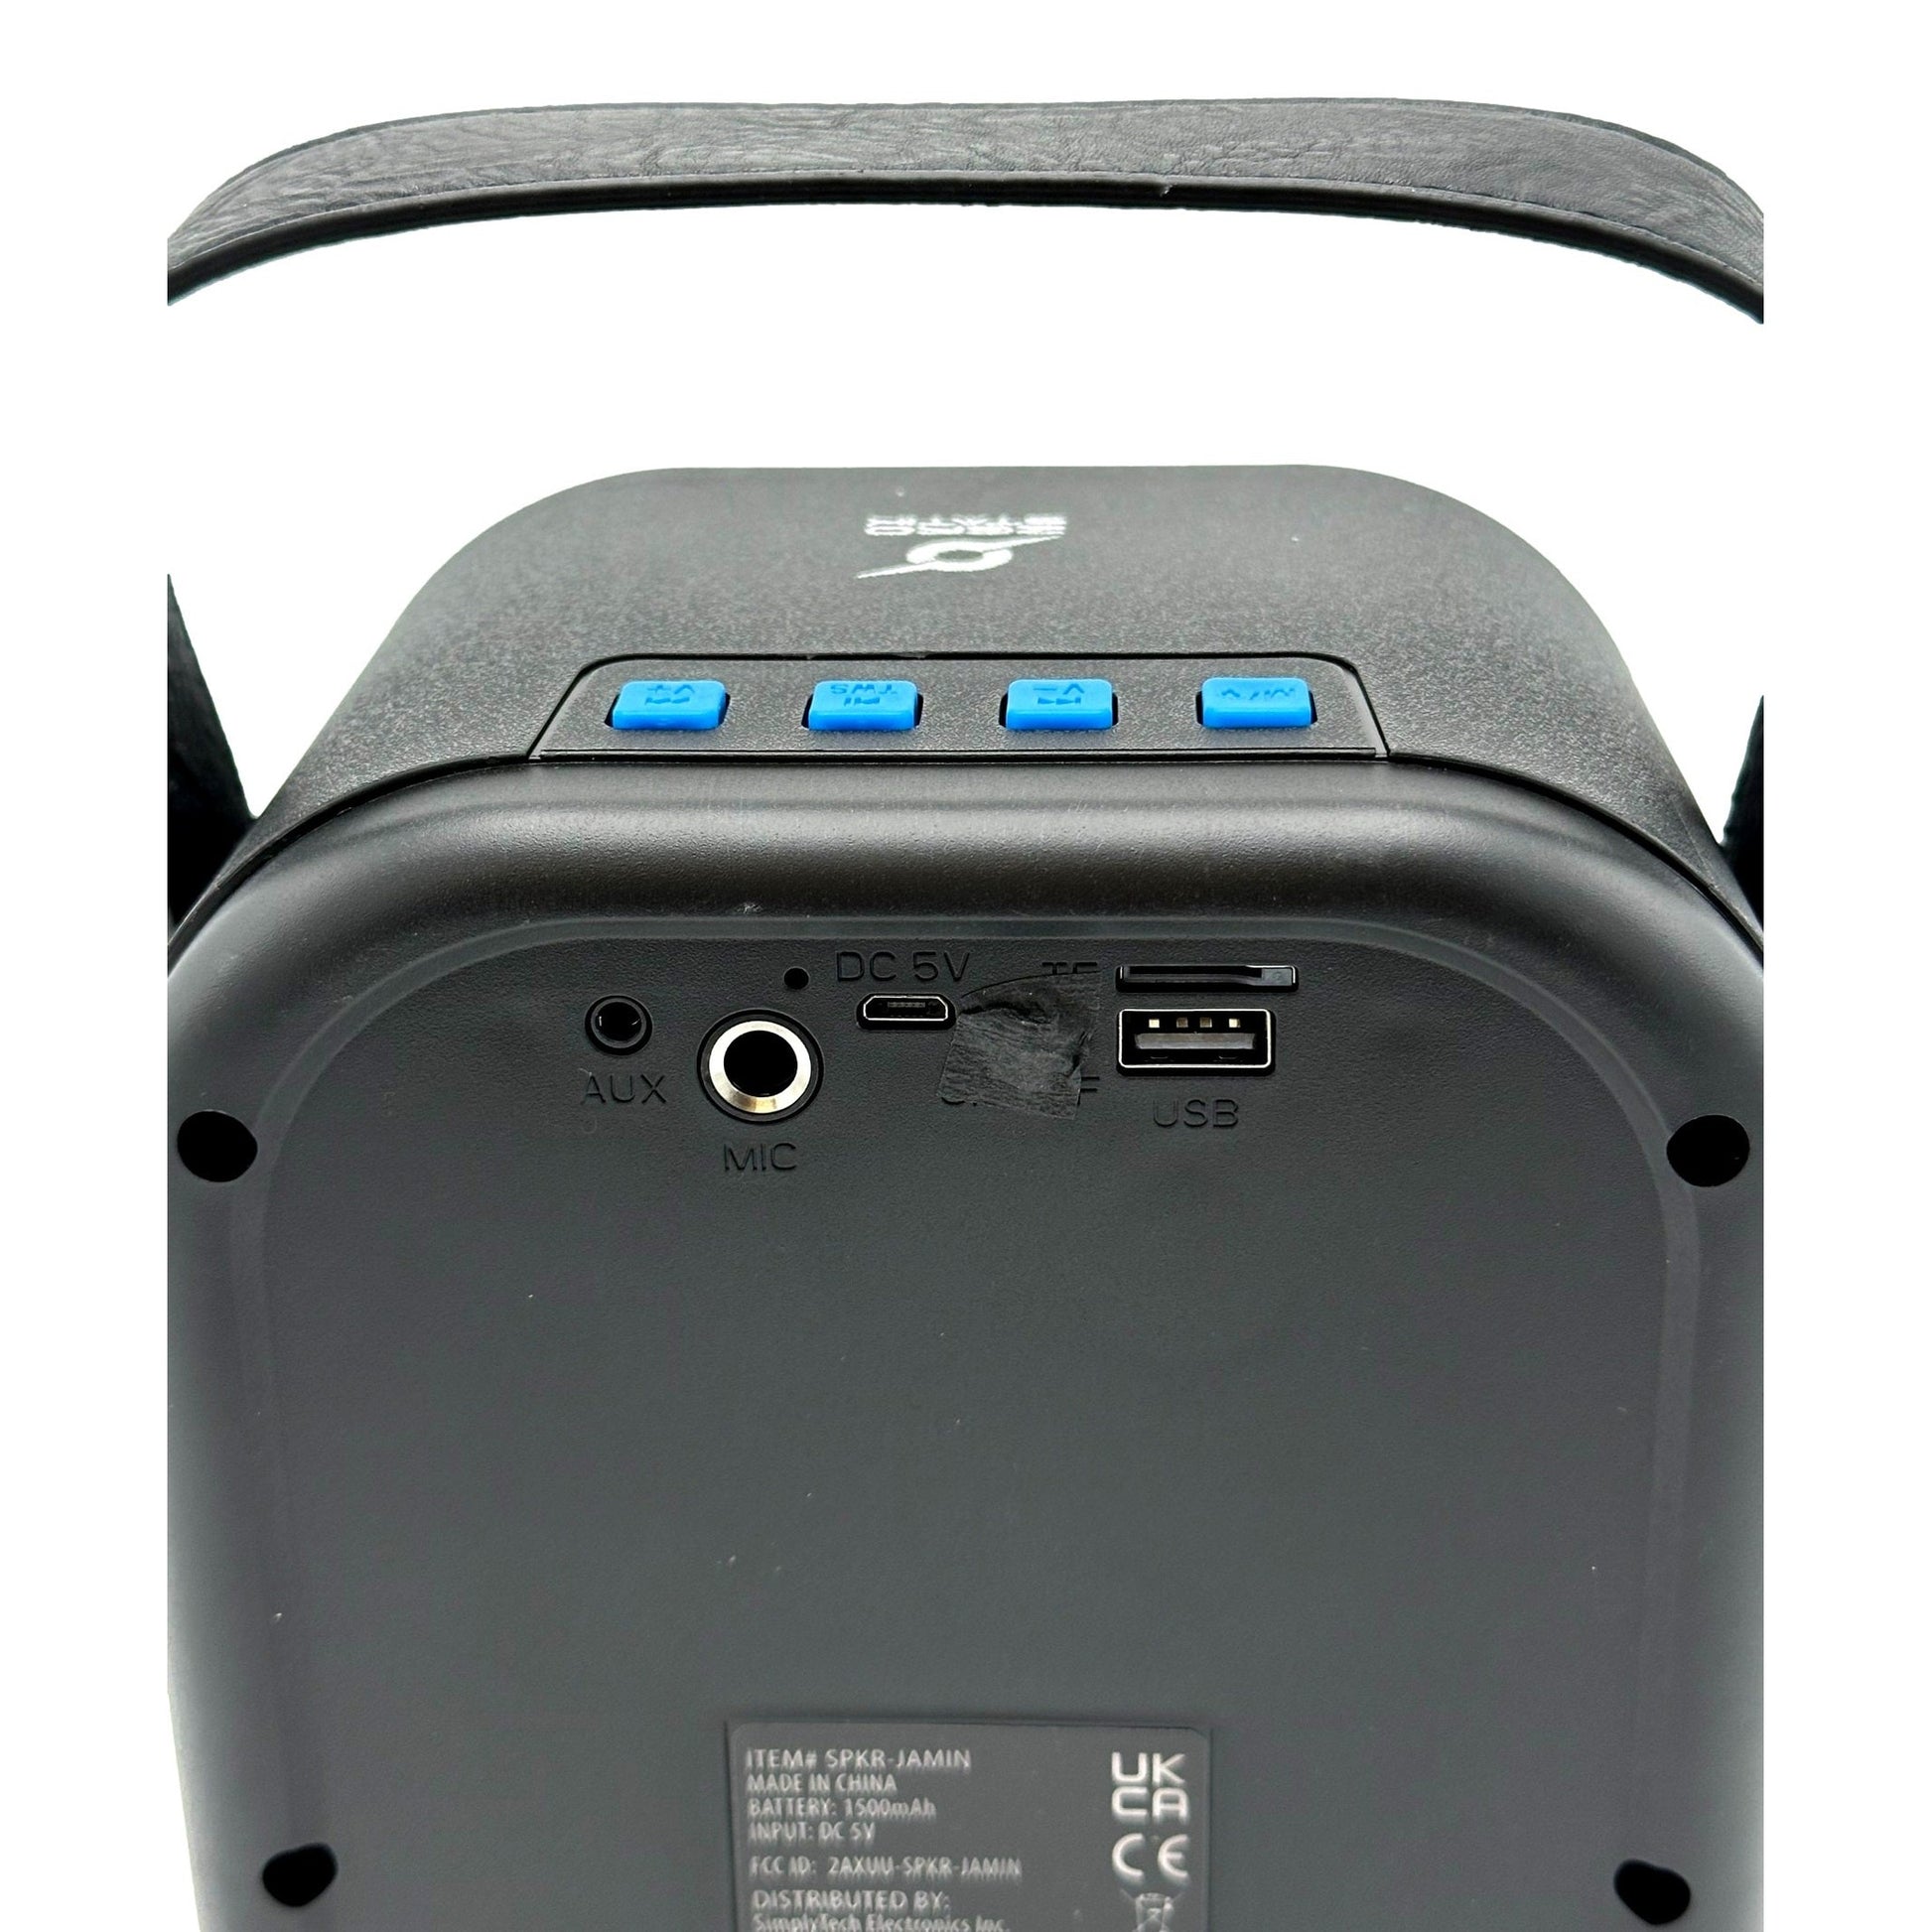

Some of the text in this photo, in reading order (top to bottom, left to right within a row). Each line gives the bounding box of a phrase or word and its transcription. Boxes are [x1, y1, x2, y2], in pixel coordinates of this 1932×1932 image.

[829, 683, 898, 695] TWS
[835, 950, 971, 982] DC 5V
[583, 1073, 666, 1104] AUX
[1152, 1098, 1239, 1128] USB
[723, 1142, 797, 1172] MIC
[746, 1748, 972, 1772] ITEM# SPKR-JAMIN
[1111, 1751, 1186, 1785] UK
[746, 1773, 898, 1794] MADE IN CHINA
[747, 1797, 937, 1819] BATTERY: 1500mAh
[1111, 1786, 1189, 1823] CA
[748, 1821, 877, 1842] INPUT: DC 5V
[750, 1856, 784, 1877] FCC
[788, 1856, 817, 1877] ID:
[752, 1889, 951, 1913] DISTRIBUTED BY:
[752, 1912, 862, 1932] SimplyTech
[866, 1912, 971, 1932] Electronics
